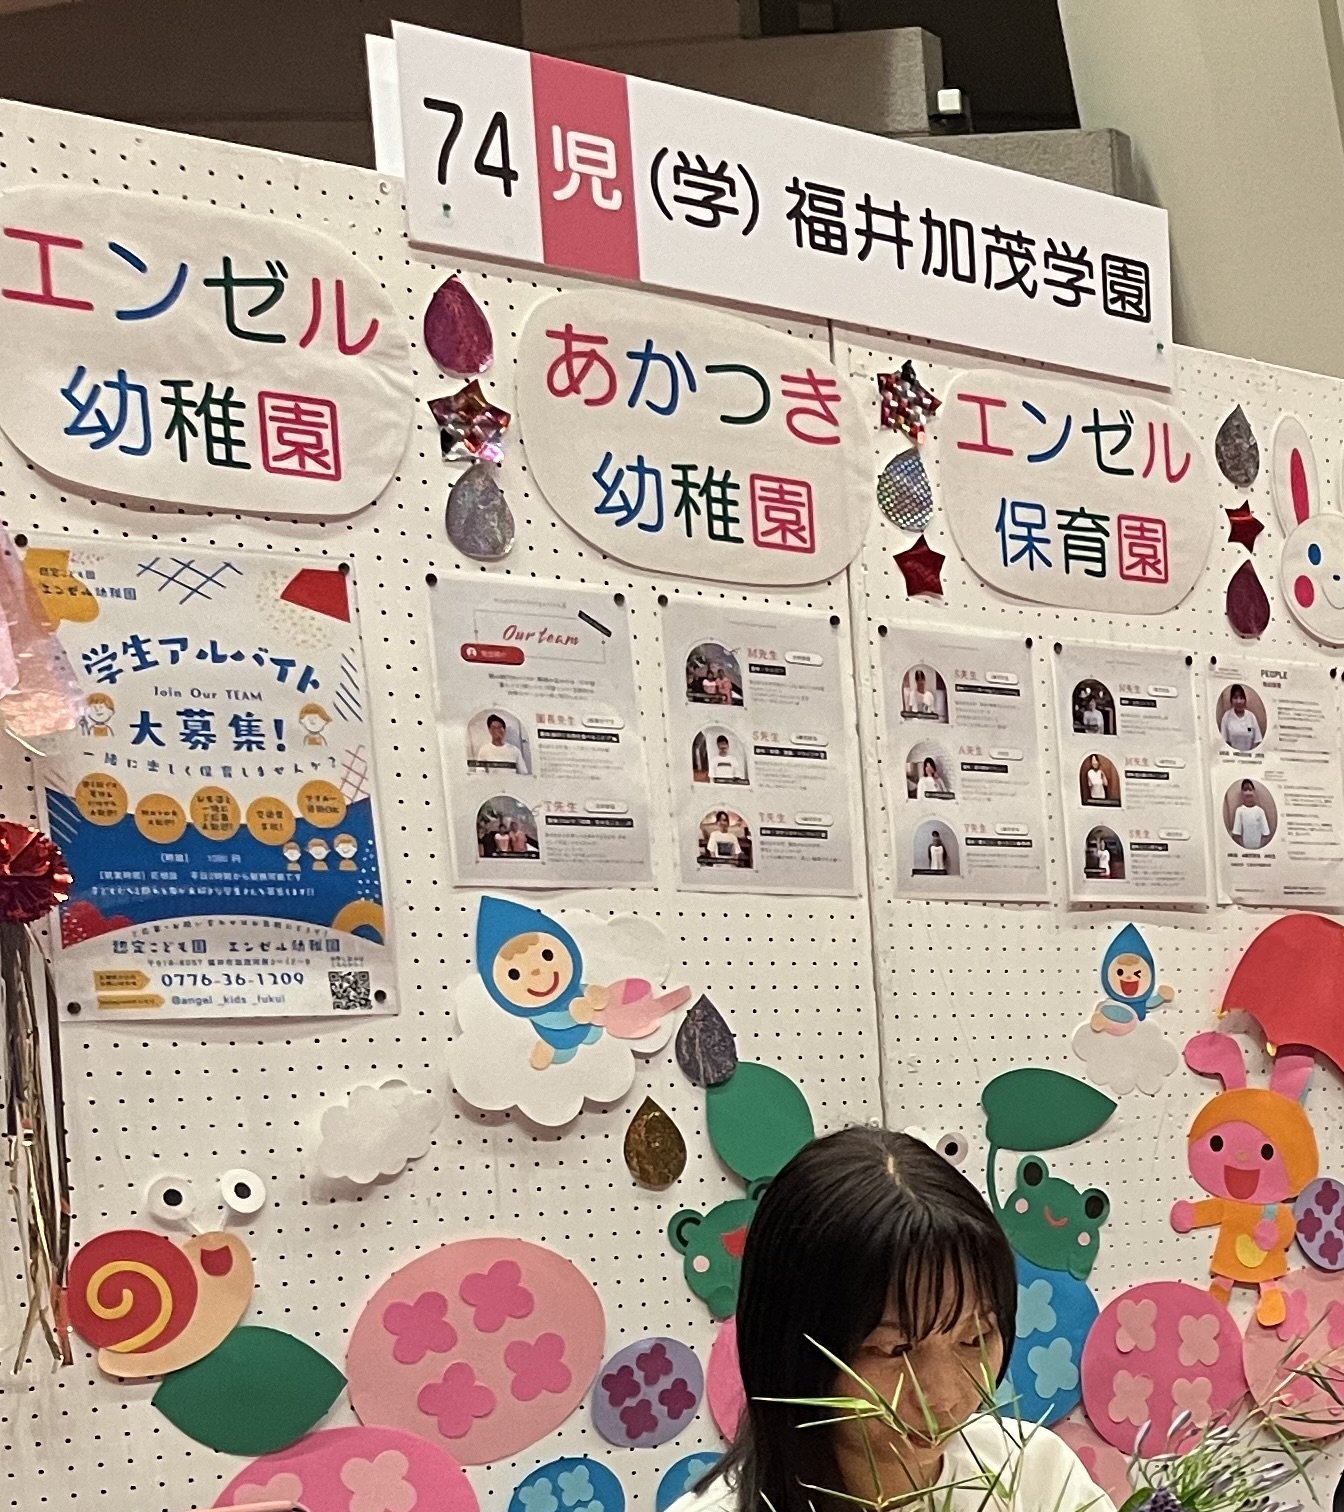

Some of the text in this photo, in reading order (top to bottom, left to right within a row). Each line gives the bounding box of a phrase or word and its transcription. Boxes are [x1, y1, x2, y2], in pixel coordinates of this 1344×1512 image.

[424, 97, 1150, 324] 74 児 (学) 福井加茂学園
[1, 228, 379, 356] エンゼル
[60, 365, 342, 481] 幼稚園
[545, 323, 841, 446] あかつき
[956, 392, 1191, 484] エンゼル
[592, 451, 815, 554] 幼稚園
[995, 497, 1168, 585] 保育園
[82, 634, 320, 693] 学生アルバイト
[503, 624, 579, 645] Our team
[129, 708, 285, 753] 大募集!
[154, 686, 262, 702] Join Our TEAM
[161, 971, 304, 987] 0776-36-1209
